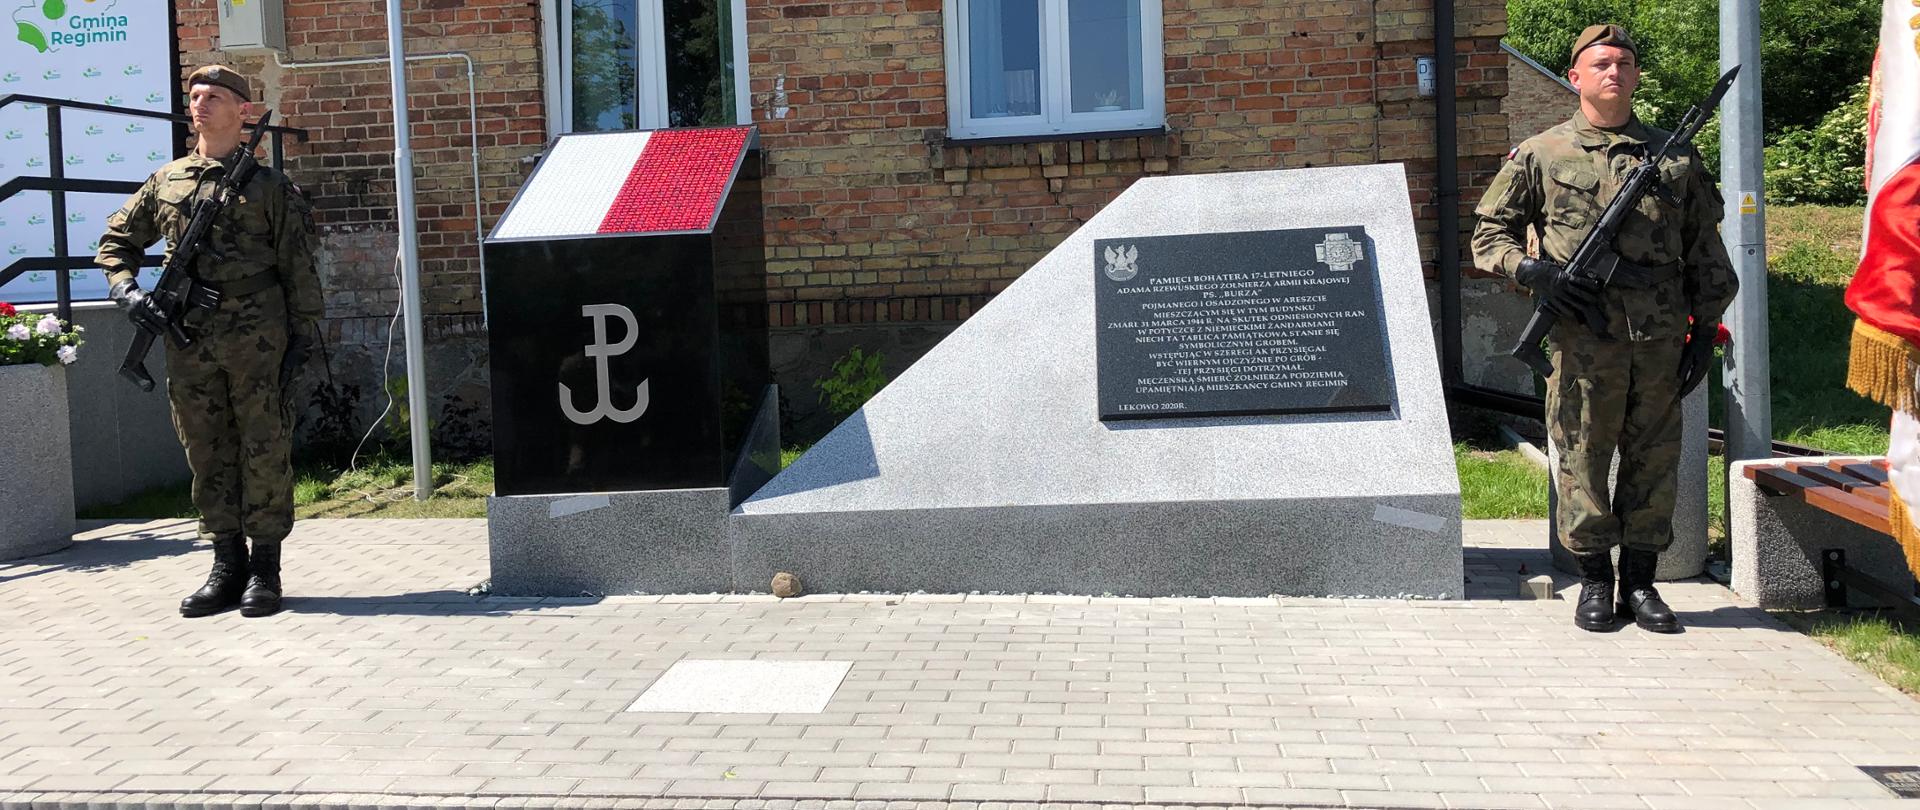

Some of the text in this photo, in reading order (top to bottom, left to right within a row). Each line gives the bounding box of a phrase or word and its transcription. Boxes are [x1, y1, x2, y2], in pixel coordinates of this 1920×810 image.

[69, 12, 128, 29] Gmina
[51, 26, 127, 47] Regimin
[1149, 269, 1315, 285] PAMIĘCI BOHATERA 17-LETNIEGO
[1117, 286, 1151, 294] ADAMA
[1152, 283, 1218, 293] RZEWUSKIEGO
[1273, 279, 1301, 287] ARMII
[1303, 276, 1350, 285] KRAJOWEJ
[1203, 291, 1217, 299] PS.
[1142, 300, 1198, 310] POJMANEGO
[1205, 298, 1271, 307] OSADZONEGO
[1283, 295, 1328, 304] ARESZCIE
[1153, 309, 1220, 319] MIESZCZĄCYM
[1221, 308, 1235, 316] SIĘ
[1269, 304, 1316, 313] BUDYNKU
[1151, 319, 1185, 327] MARCA
[1231, 315, 1269, 323] SKUTEK
[1270, 311, 1343, 321] ODNIESIONYCH
[1344, 310, 1365, 318] RAN
[1148, 326, 1195, 335] POTYCZCE
[1205, 323, 1266, 333] NIEMIECKIMI
[1180, 333, 1220, 342] TABLICA
[1289, 329, 1324, 337] STANIE
[1325, 328, 1340, 337] SIĘ
[1178, 338, 1299, 349] SYMBOLICZNYM GROBEM.
[1148, 351, 1202, 361] WSTĘPUJĄC
[1214, 348, 1253, 357] SZEREGI
[1175, 359, 1220, 367] WIERNYM
[1275, 355, 1288, 363] PO
[1193, 366, 1241, 376] PRZYSIĘGI
[1290, 371, 1344, 379] PODZIEMIA
[1306, 379, 1348, 387] REGIMIN
[1118, 402, 1188, 411] LEKOWO 2020R.
